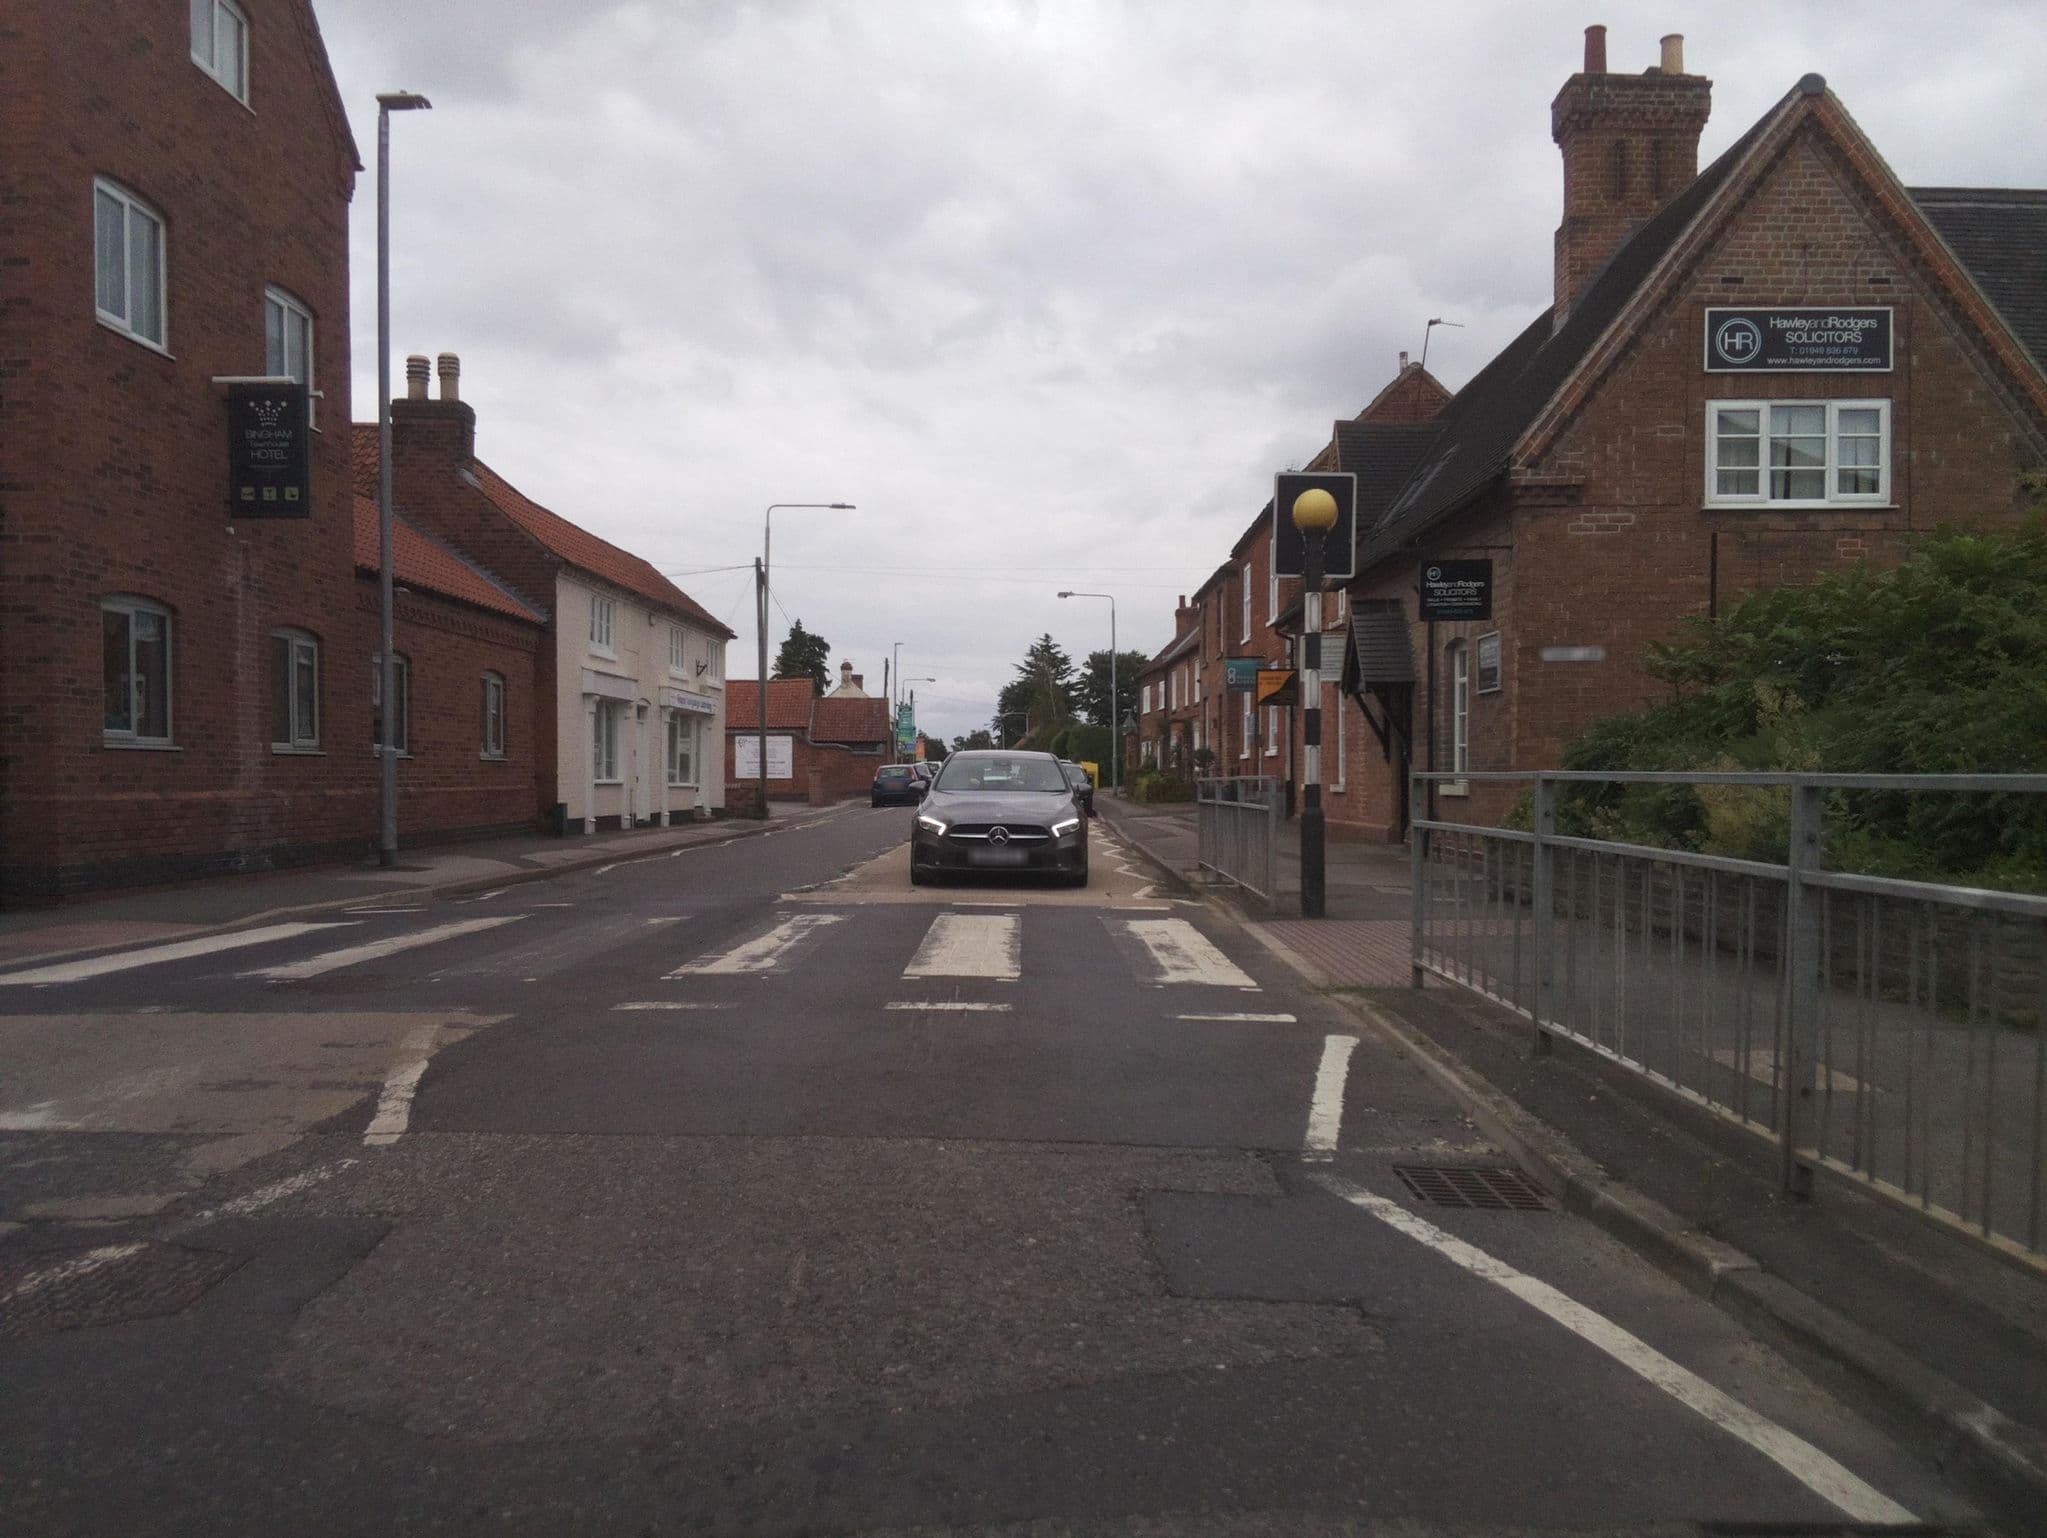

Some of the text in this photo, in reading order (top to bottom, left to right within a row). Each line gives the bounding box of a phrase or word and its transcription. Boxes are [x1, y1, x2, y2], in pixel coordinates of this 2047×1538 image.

[1724, 332, 1753, 350] HR
[1785, 331, 1863, 344] SOLICITORS
[1767, 356, 1881, 366] www.hawleyandrodgers.com
[250, 449, 289, 460] HOTEL
[1433, 588, 1478, 597] SOLICITORS
